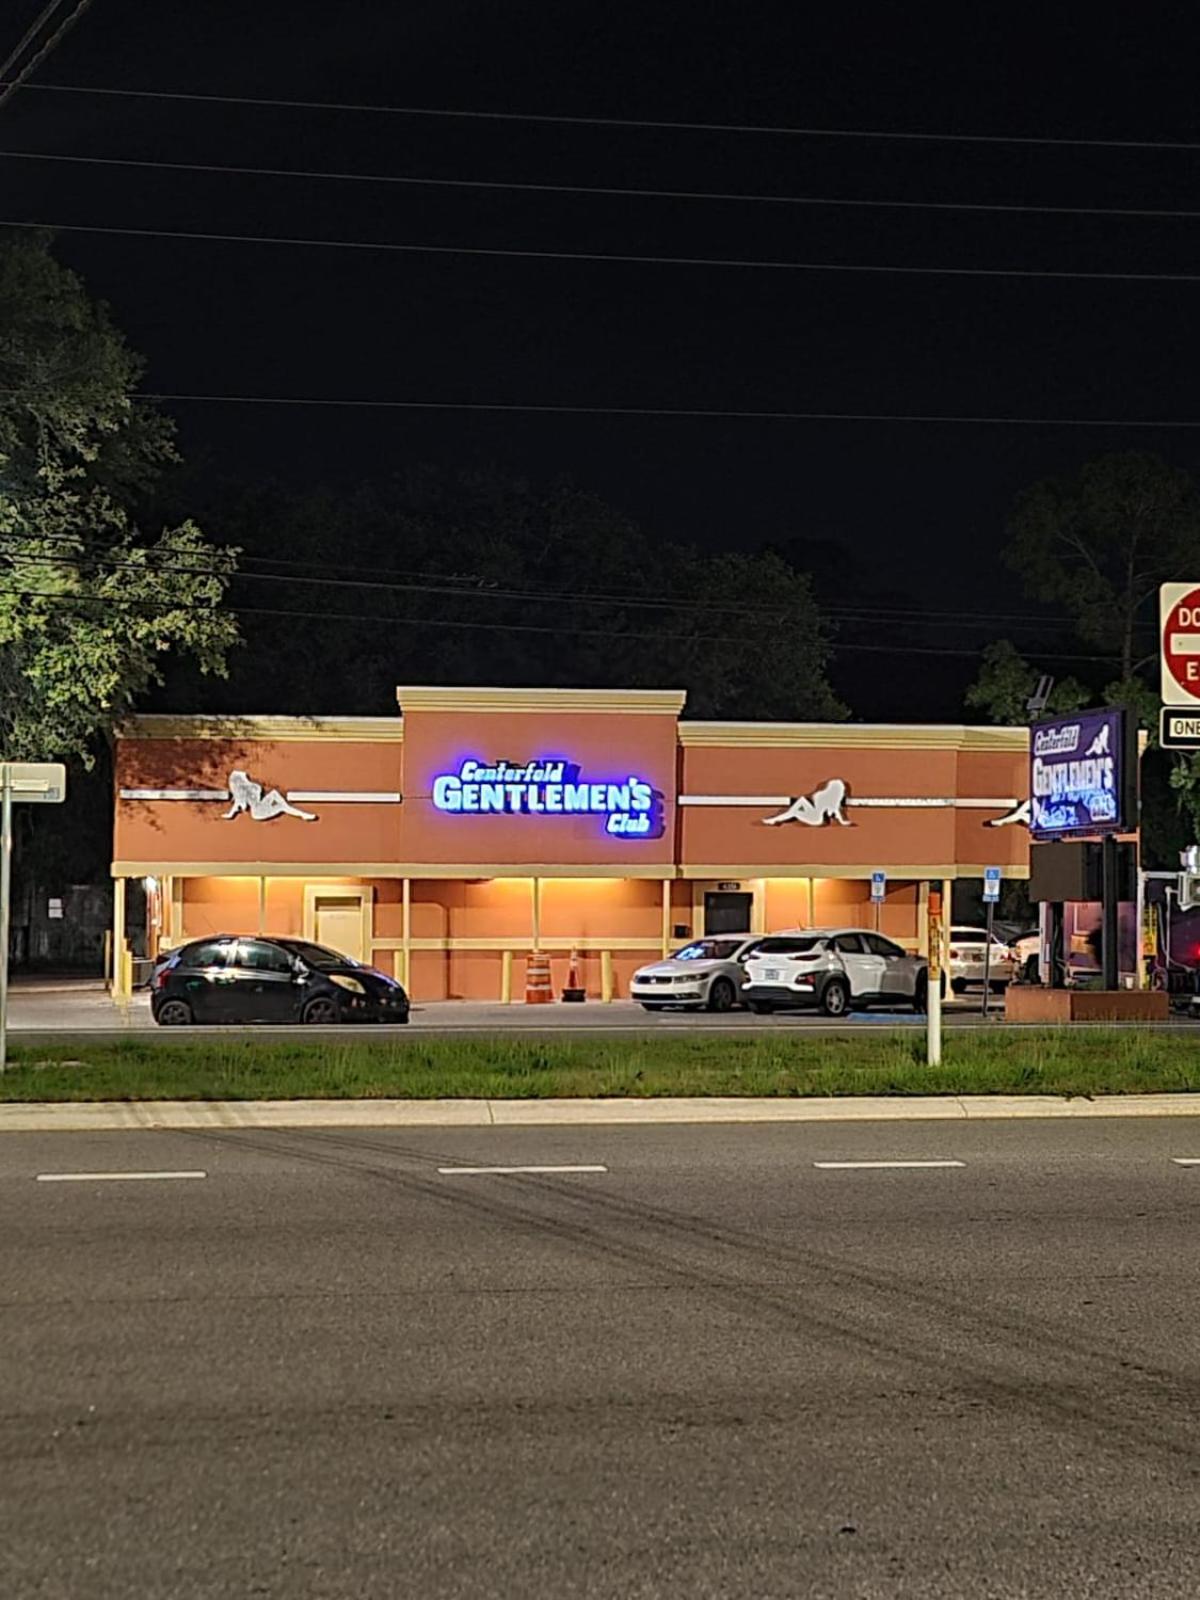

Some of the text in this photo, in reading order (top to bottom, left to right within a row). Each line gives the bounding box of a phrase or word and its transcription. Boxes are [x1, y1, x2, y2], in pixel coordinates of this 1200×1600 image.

[461, 761, 564, 782] Centerfold
[433, 776, 651, 811] GENTLEMEN'S
[607, 813, 650, 832] Club
